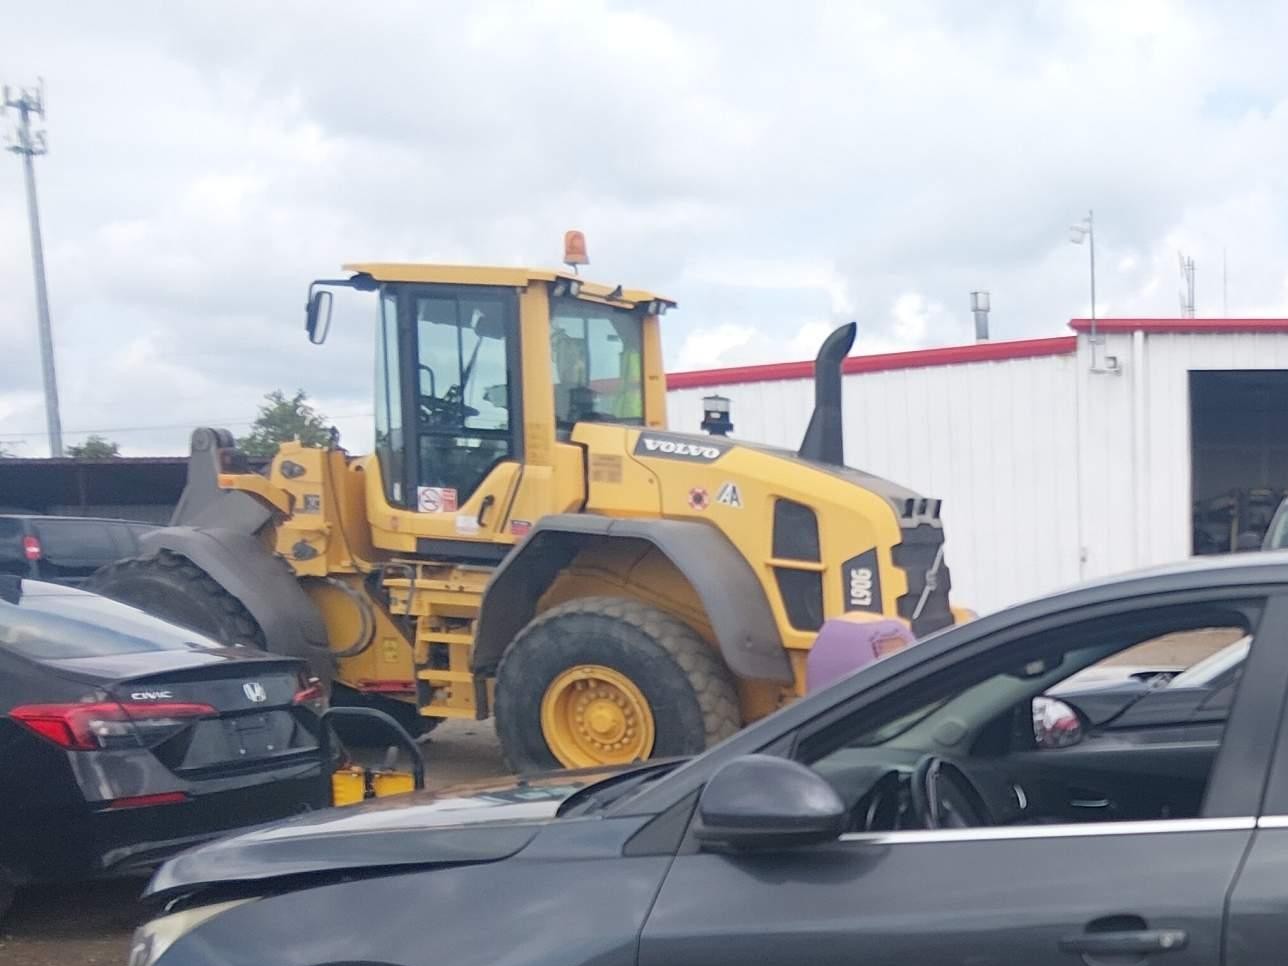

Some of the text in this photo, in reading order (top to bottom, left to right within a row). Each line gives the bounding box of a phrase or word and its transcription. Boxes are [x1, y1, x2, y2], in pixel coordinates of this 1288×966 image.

[643, 438, 721, 460] VOLVO
[850, 567, 873, 607] L90G
[131, 690, 173, 700] CIVIC
